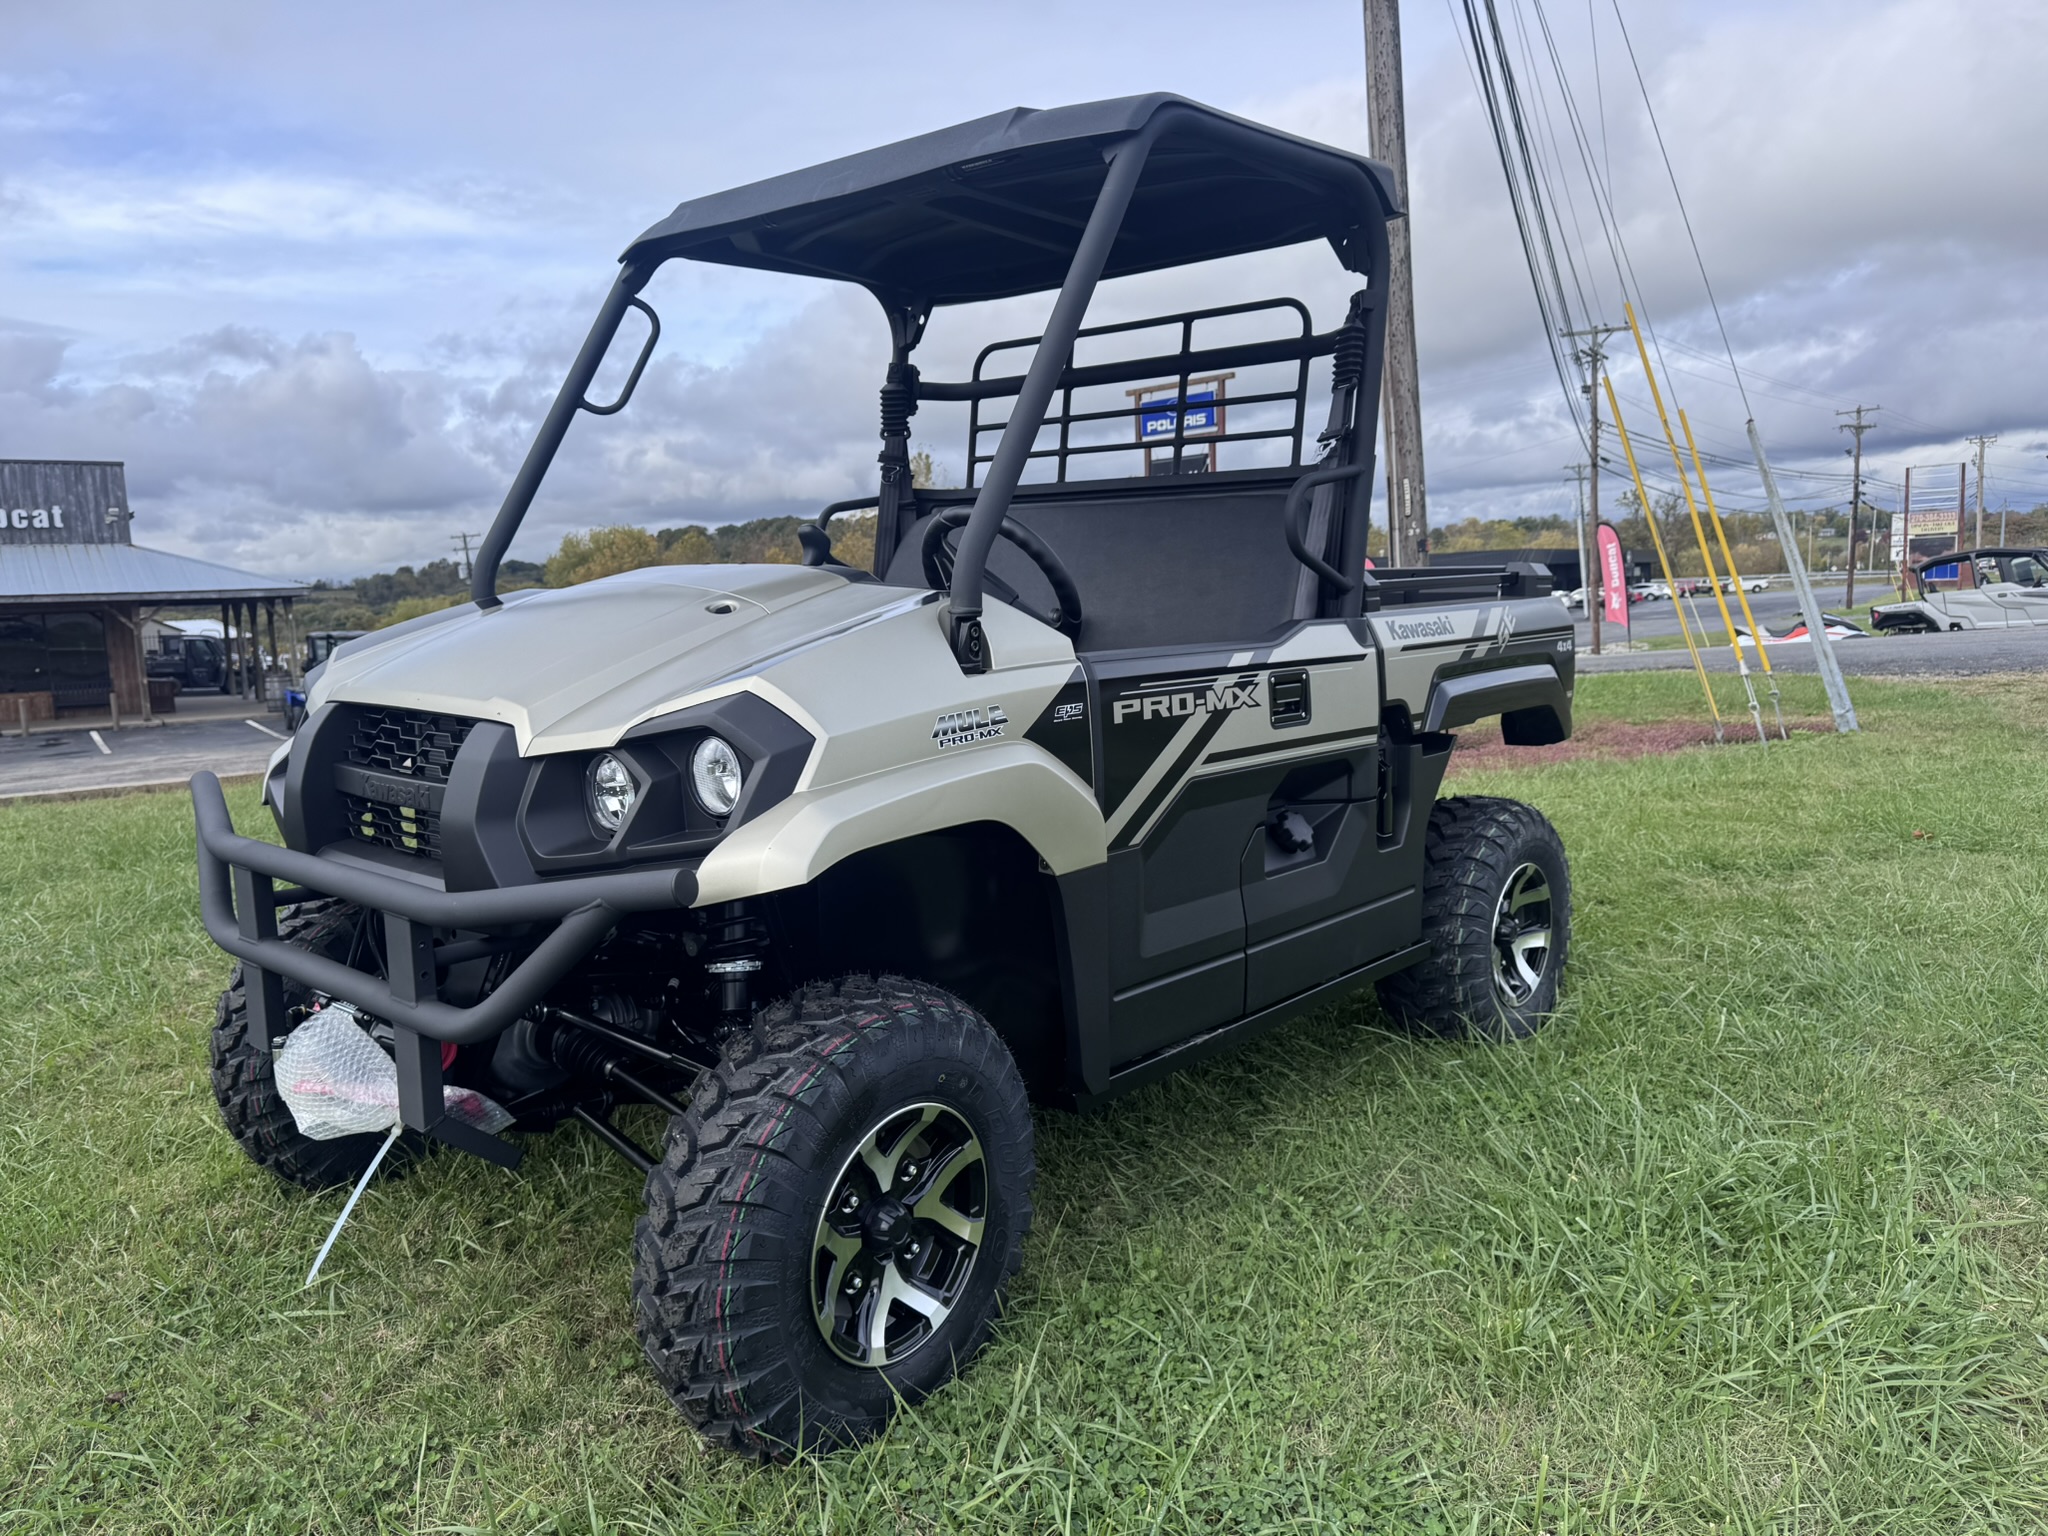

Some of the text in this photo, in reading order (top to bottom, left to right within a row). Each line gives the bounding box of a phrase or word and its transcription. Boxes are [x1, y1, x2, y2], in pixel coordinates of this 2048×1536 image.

[1147, 413, 1207, 433] POLRIS
[1385, 615, 1455, 641] Kawasaki
[1557, 640, 1572, 652] 4x4
[1113, 684, 1262, 724] PRO-MX
[931, 704, 1009, 739] MULE
[938, 726, 1004, 749] PRO-MX
[360, 773, 431, 810] Kawasaki
